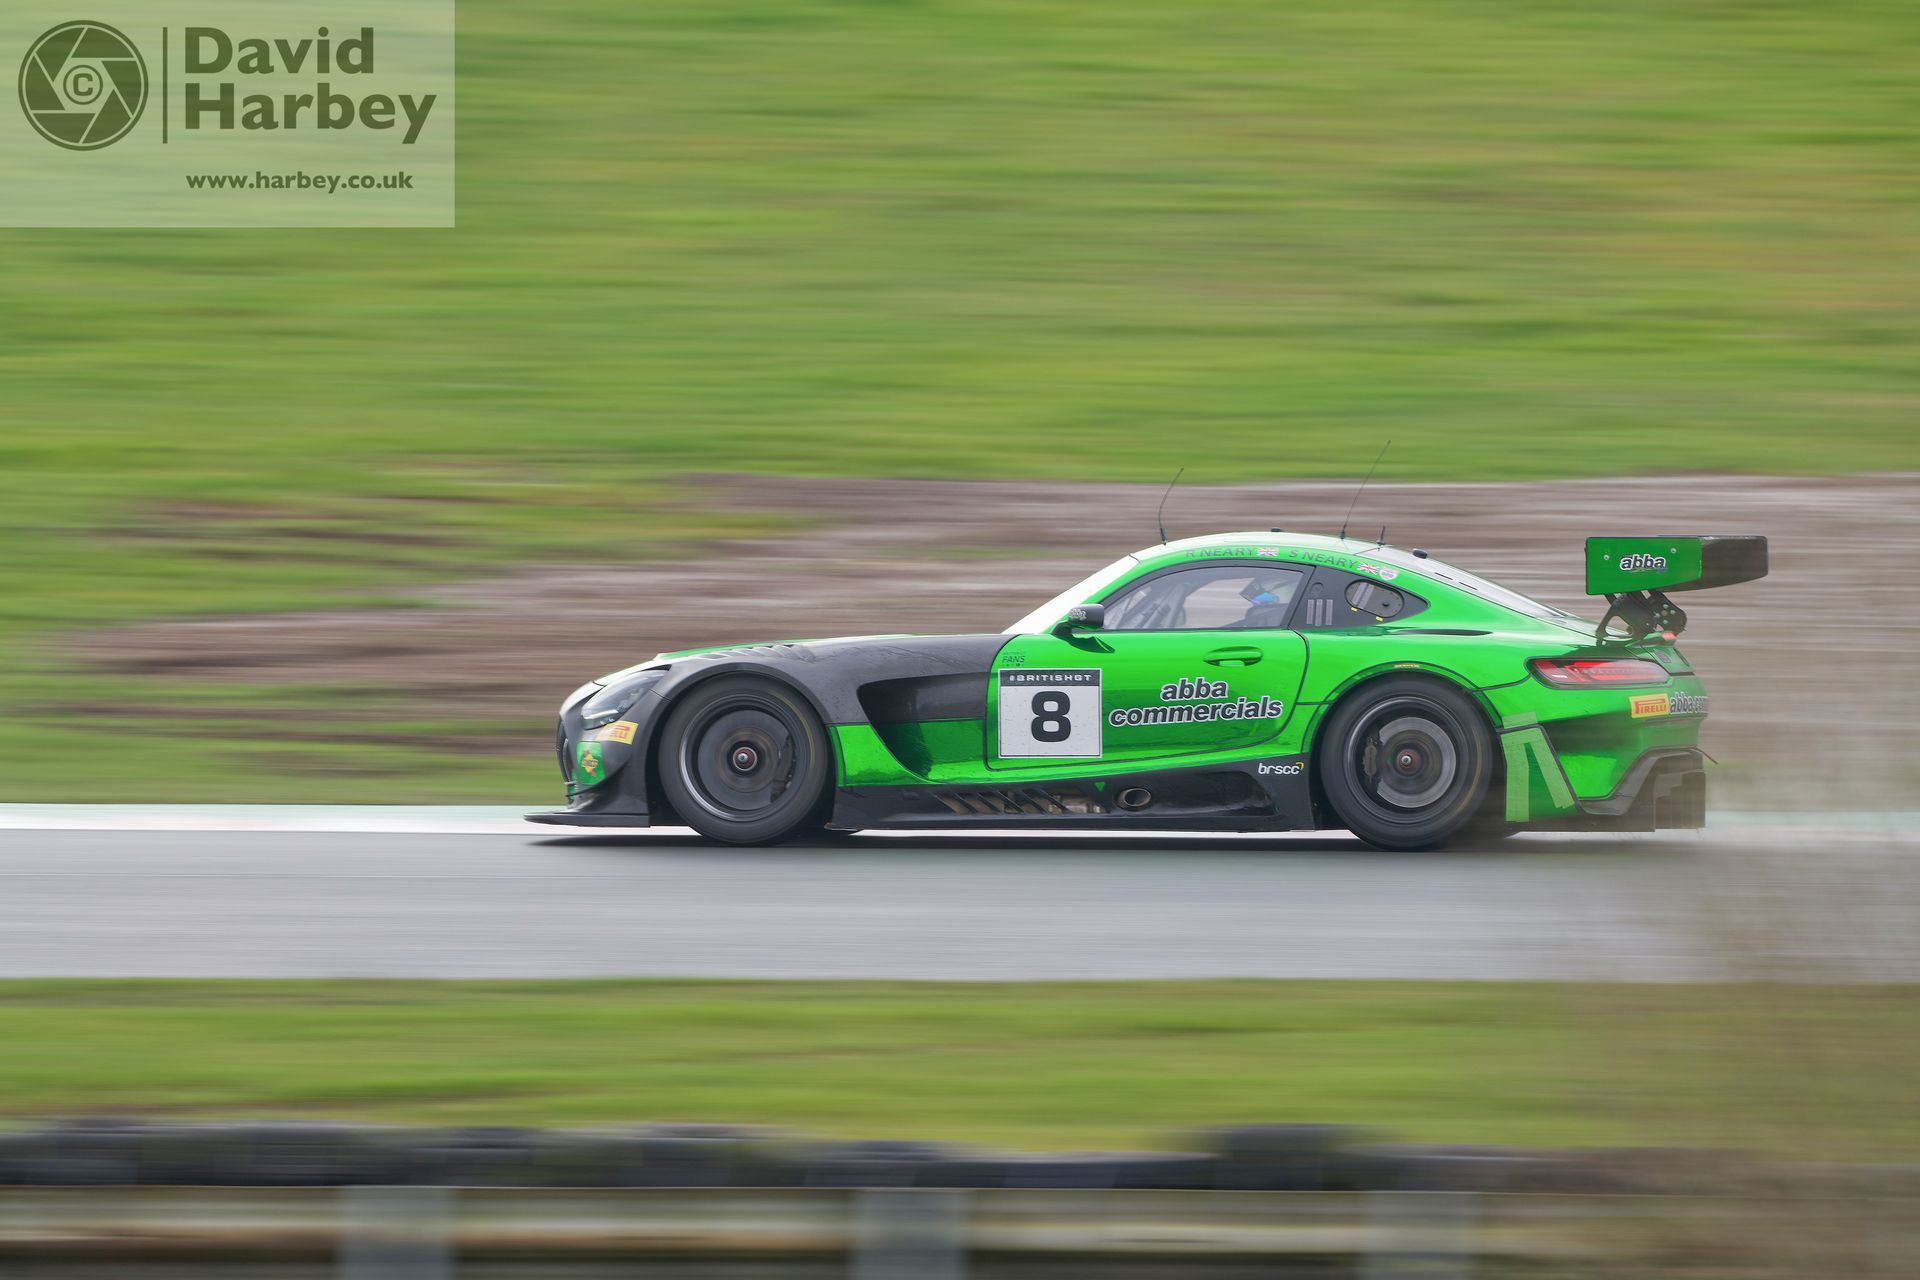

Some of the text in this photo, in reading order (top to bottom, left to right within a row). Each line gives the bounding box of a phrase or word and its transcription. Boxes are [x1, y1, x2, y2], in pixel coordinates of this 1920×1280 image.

[1185, 547, 1254, 558] R NEARY
[1288, 549, 1359, 569] S NEARY
[1620, 553, 1666, 570] abba
[1009, 674, 1092, 682] #BRITISHGT
[1160, 677, 1229, 702] abba
[1109, 696, 1283, 726] commercials
[1634, 698, 1667, 714] PIRELLI
[1031, 691, 1071, 742] 8
[1258, 762, 1302, 775] brscc
